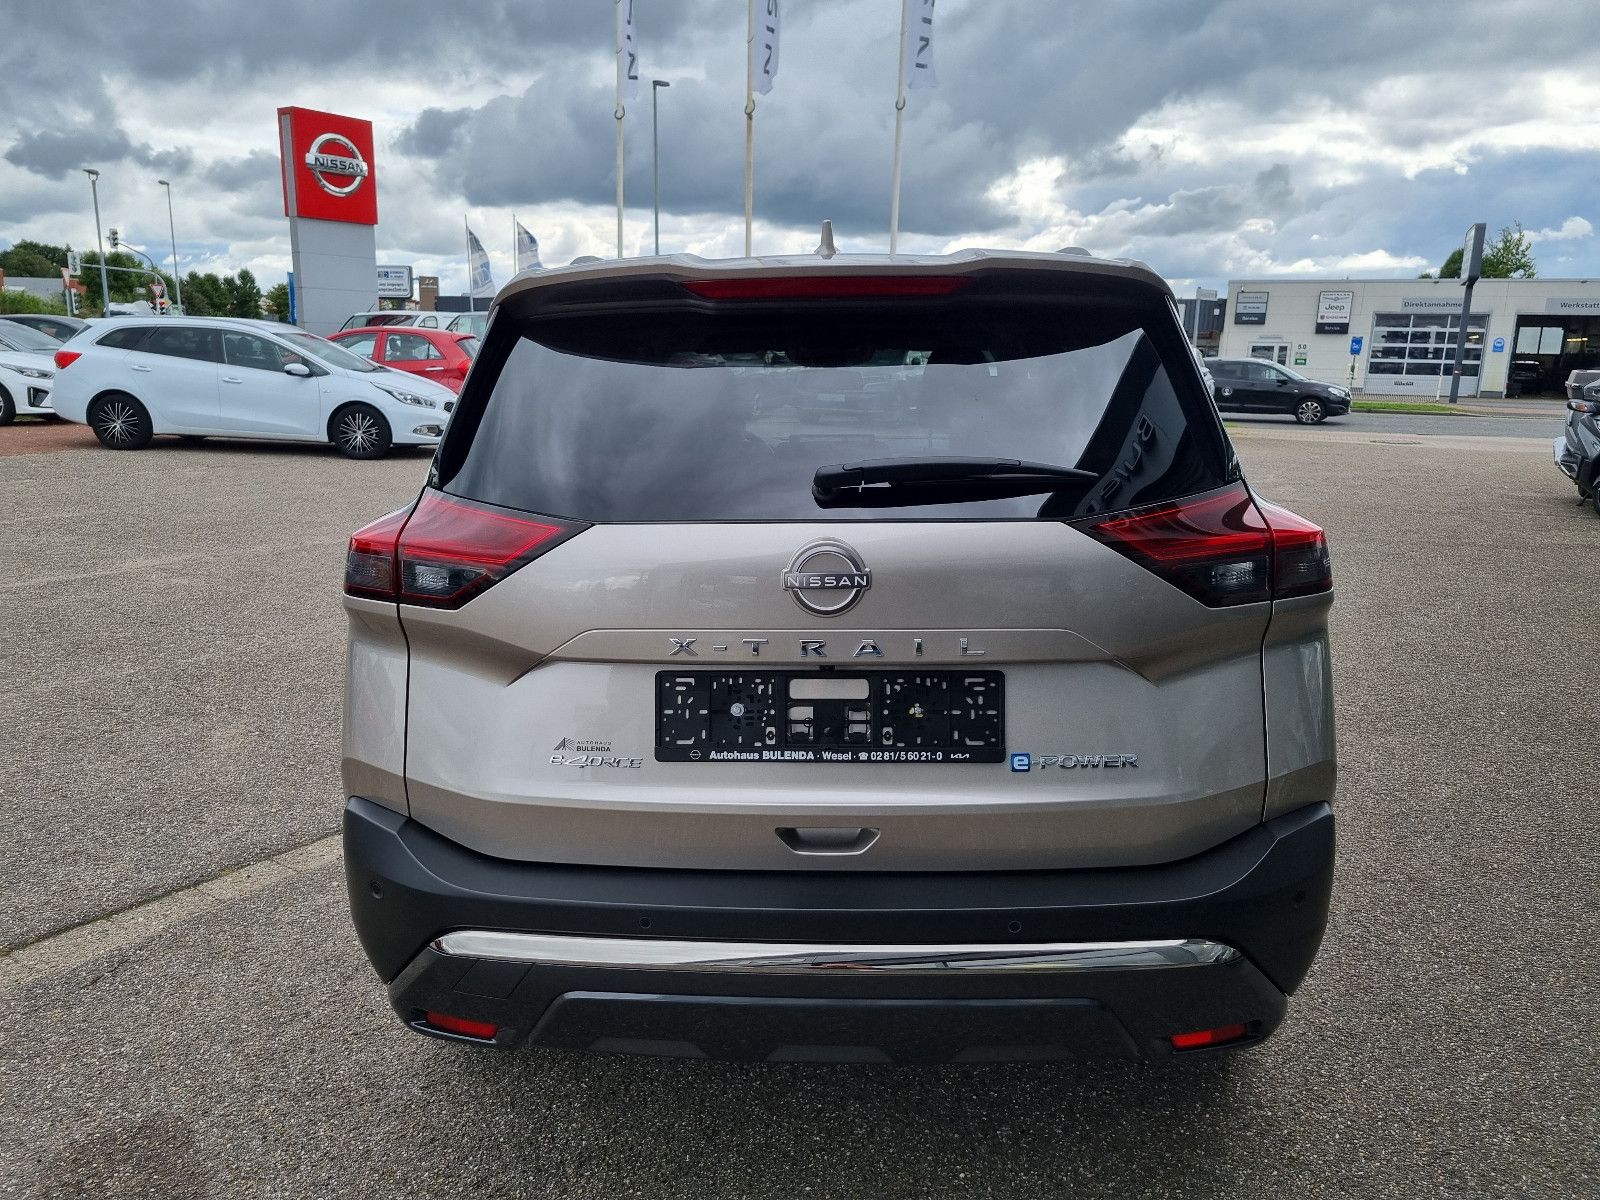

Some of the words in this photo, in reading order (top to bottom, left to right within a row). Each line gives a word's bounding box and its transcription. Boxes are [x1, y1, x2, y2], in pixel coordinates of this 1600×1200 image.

[314, 157, 363, 174] NISSAN
[1325, 303, 1345, 311] Jeep
[786, 573, 868, 588] NISSAN
[668, 637, 986, 657] X-TRAIL
[709, 750, 760, 761] Autohaus
[762, 750, 814, 761] BULENDA
[822, 751, 852, 761] Wesel
